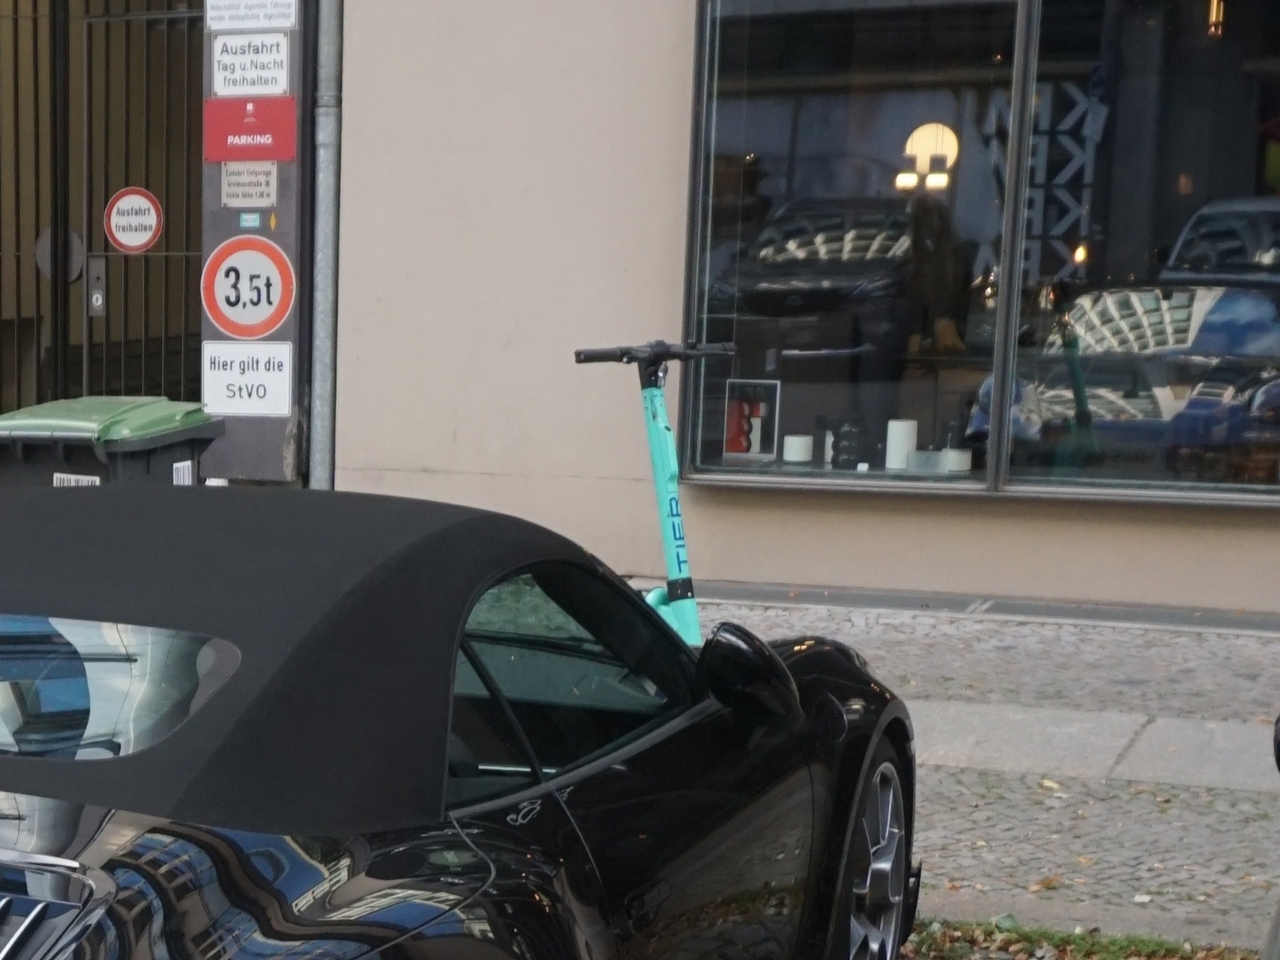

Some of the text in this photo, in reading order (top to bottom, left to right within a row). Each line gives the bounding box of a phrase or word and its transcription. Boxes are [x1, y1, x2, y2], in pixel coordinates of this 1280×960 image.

[220, 41, 280, 55] Ausfahrt
[216, 60, 235, 74] Tag
[224, 75, 277, 87] freihalten
[227, 135, 272, 145] PARKING
[116, 206, 151, 218] Ausfahrt
[114, 222, 153, 234] freihalten
[209, 356, 284, 375] Hier gilt die
[226, 384, 267, 399] StVO
[669, 497, 688, 573] TIER
